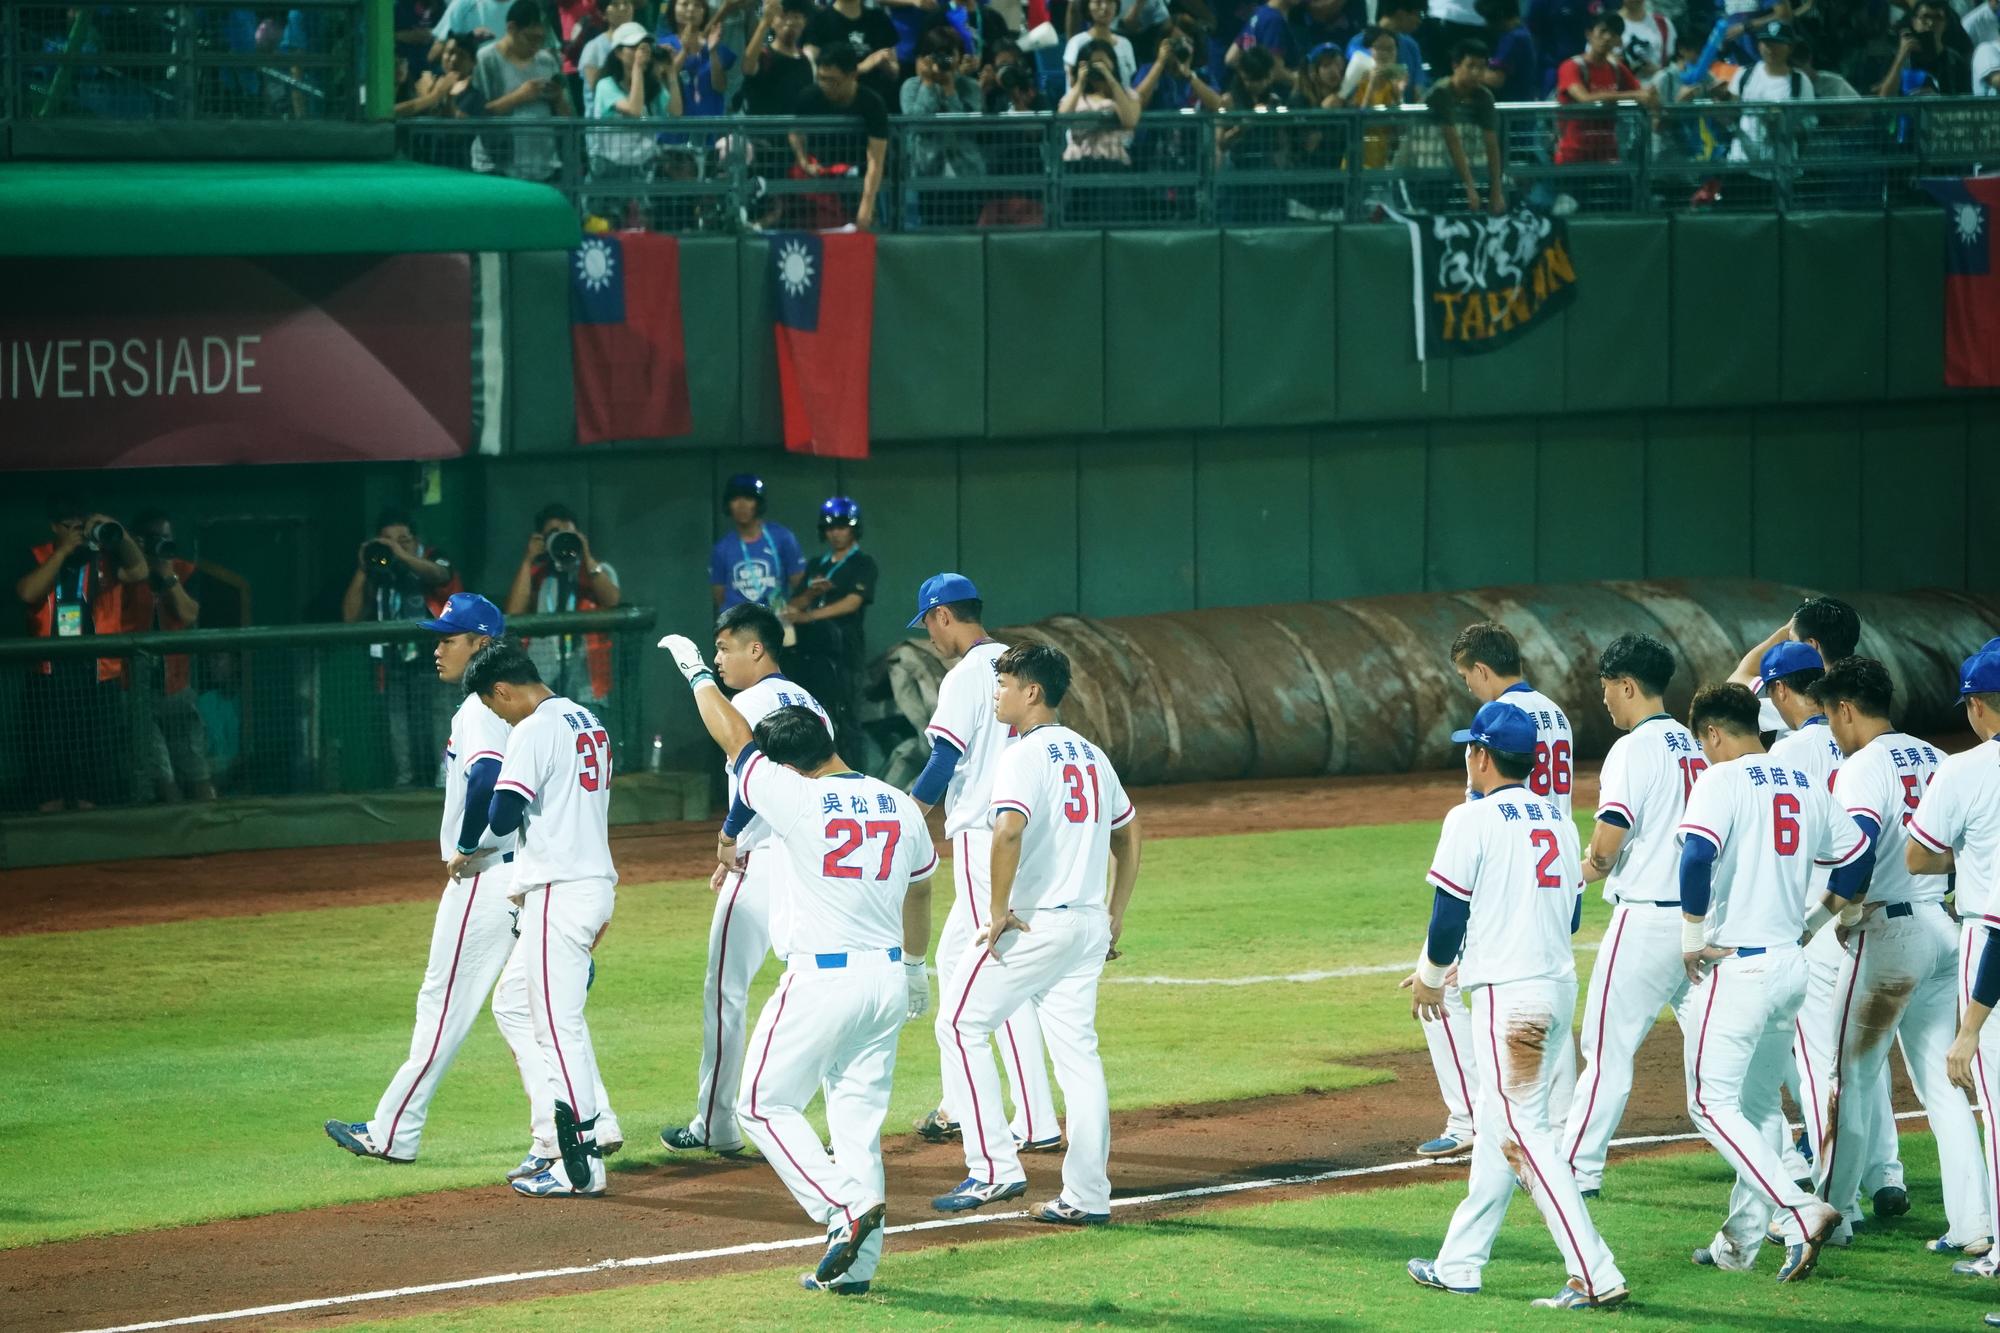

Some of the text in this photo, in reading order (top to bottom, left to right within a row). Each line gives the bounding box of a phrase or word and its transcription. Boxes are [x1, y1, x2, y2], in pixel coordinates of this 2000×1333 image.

[0, 335, 262, 399] IVERSIADE
[576, 729, 612, 792] 37
[1529, 739, 1571, 796] 86
[1062, 763, 1099, 824] 31
[1772, 792, 1801, 857] 6
[1899, 773, 1936, 828] 5
[822, 817, 901, 881] 27
[1529, 828, 1561, 889] 2
